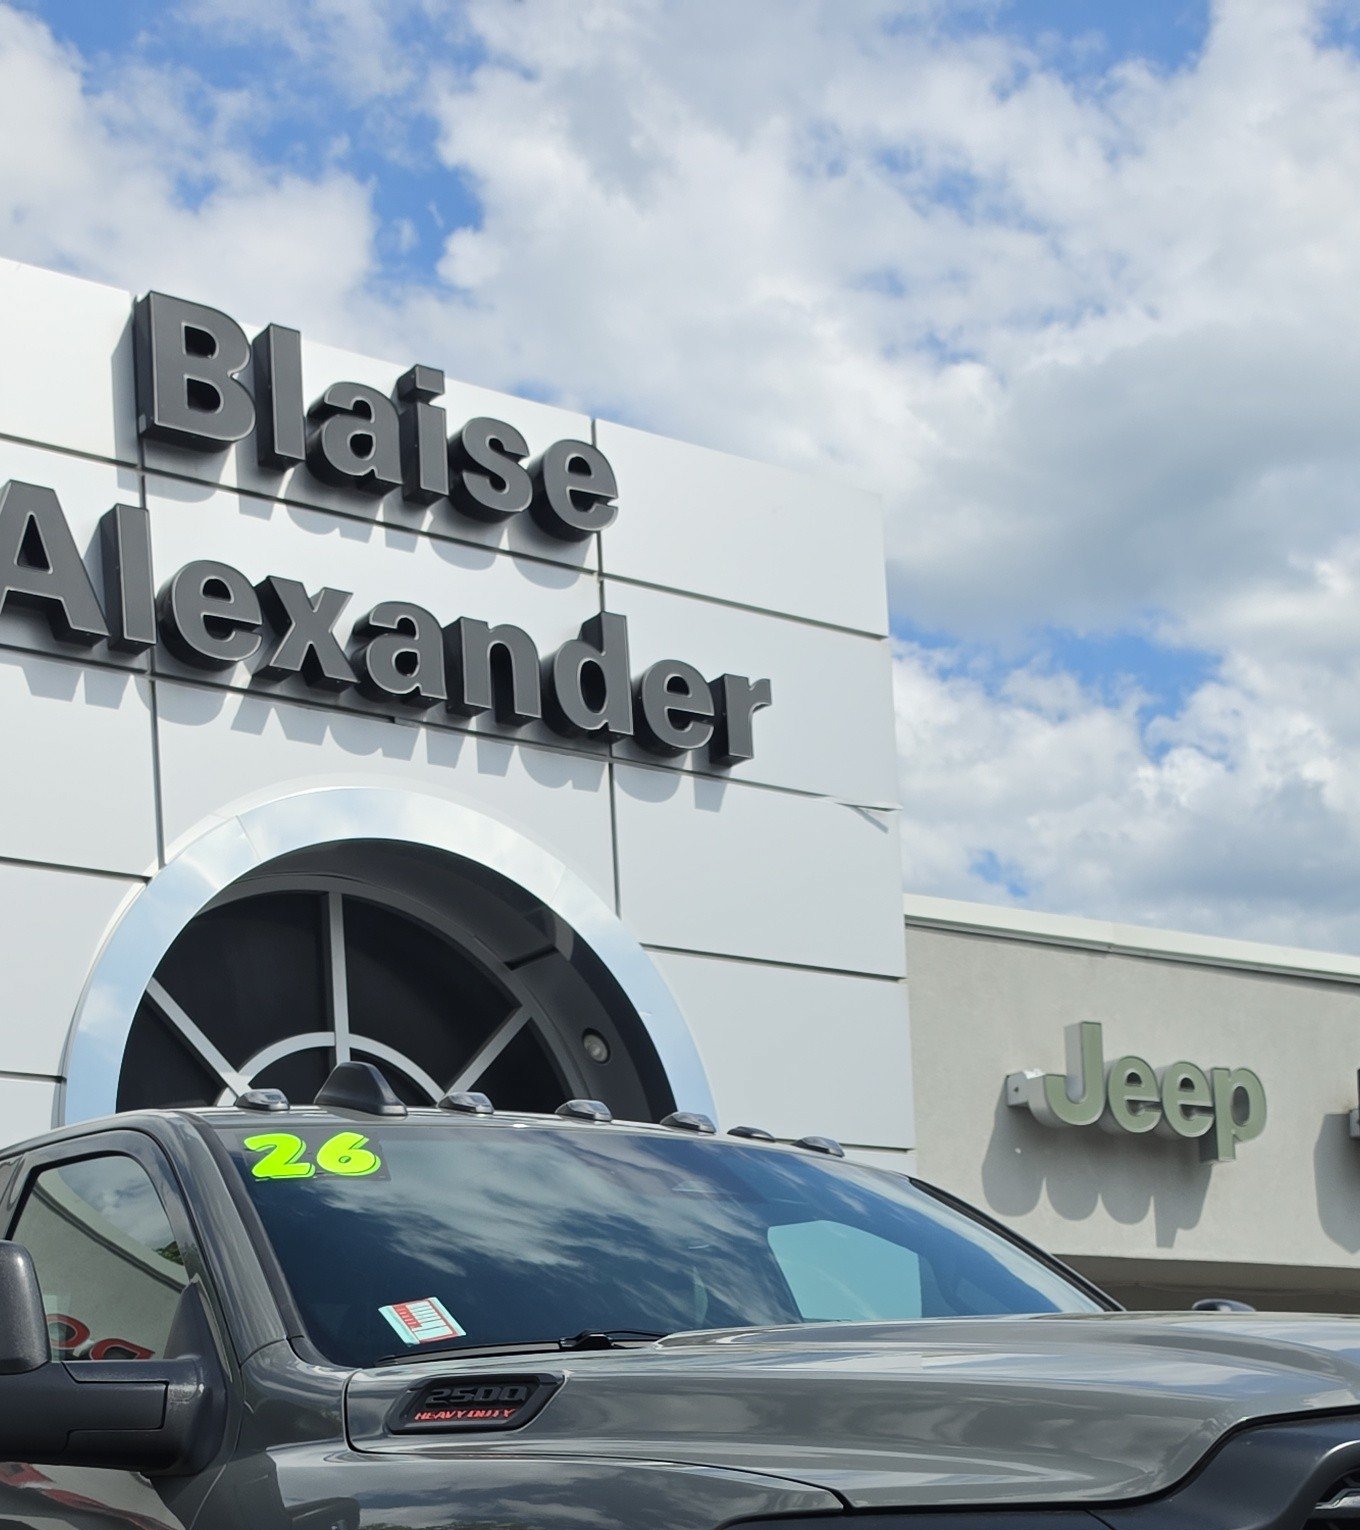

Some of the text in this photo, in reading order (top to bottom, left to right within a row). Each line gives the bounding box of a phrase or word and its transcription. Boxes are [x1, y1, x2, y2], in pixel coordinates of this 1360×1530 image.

[135, 290, 618, 541] Blaise
[1036, 1021, 1268, 1162] Jeep
[245, 1132, 381, 1178] 26
[414, 1409, 466, 1421] HEAVY
[426, 1385, 528, 1404] 2500
